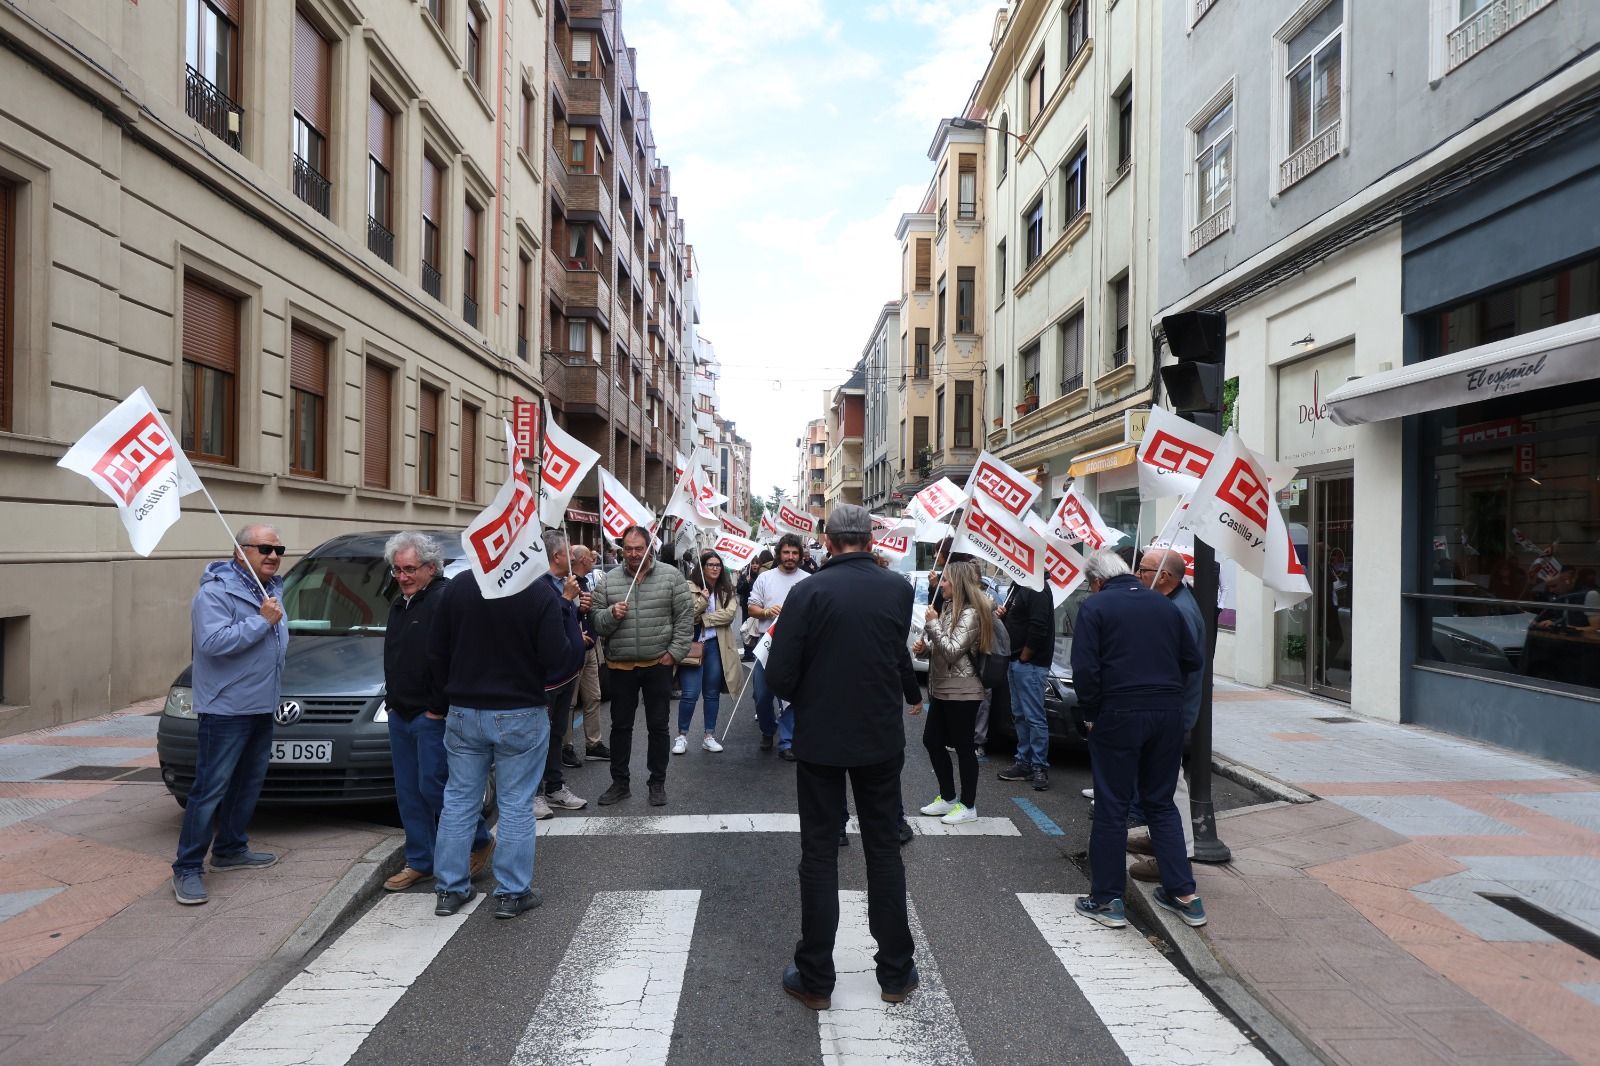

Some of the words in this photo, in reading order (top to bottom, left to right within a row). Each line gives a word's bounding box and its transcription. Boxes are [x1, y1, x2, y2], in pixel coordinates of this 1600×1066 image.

[1466, 367, 1487, 391] El
[1487, 354, 1548, 392] español
[517, 403, 531, 458] CCOO
[103, 422, 171, 494] CCOO
[1152, 439, 1209, 478] CC
[134, 485, 170, 521] Castilla
[977, 468, 1025, 508] CCOO
[1229, 470, 1269, 519] CC
[781, 508, 810, 531] CCOO
[1219, 511, 1252, 541] Castilla
[1251, 535, 1264, 549] y
[968, 533, 998, 562] Castilla
[1005, 560, 1027, 579] León
[292, 744, 326, 760] DSG
